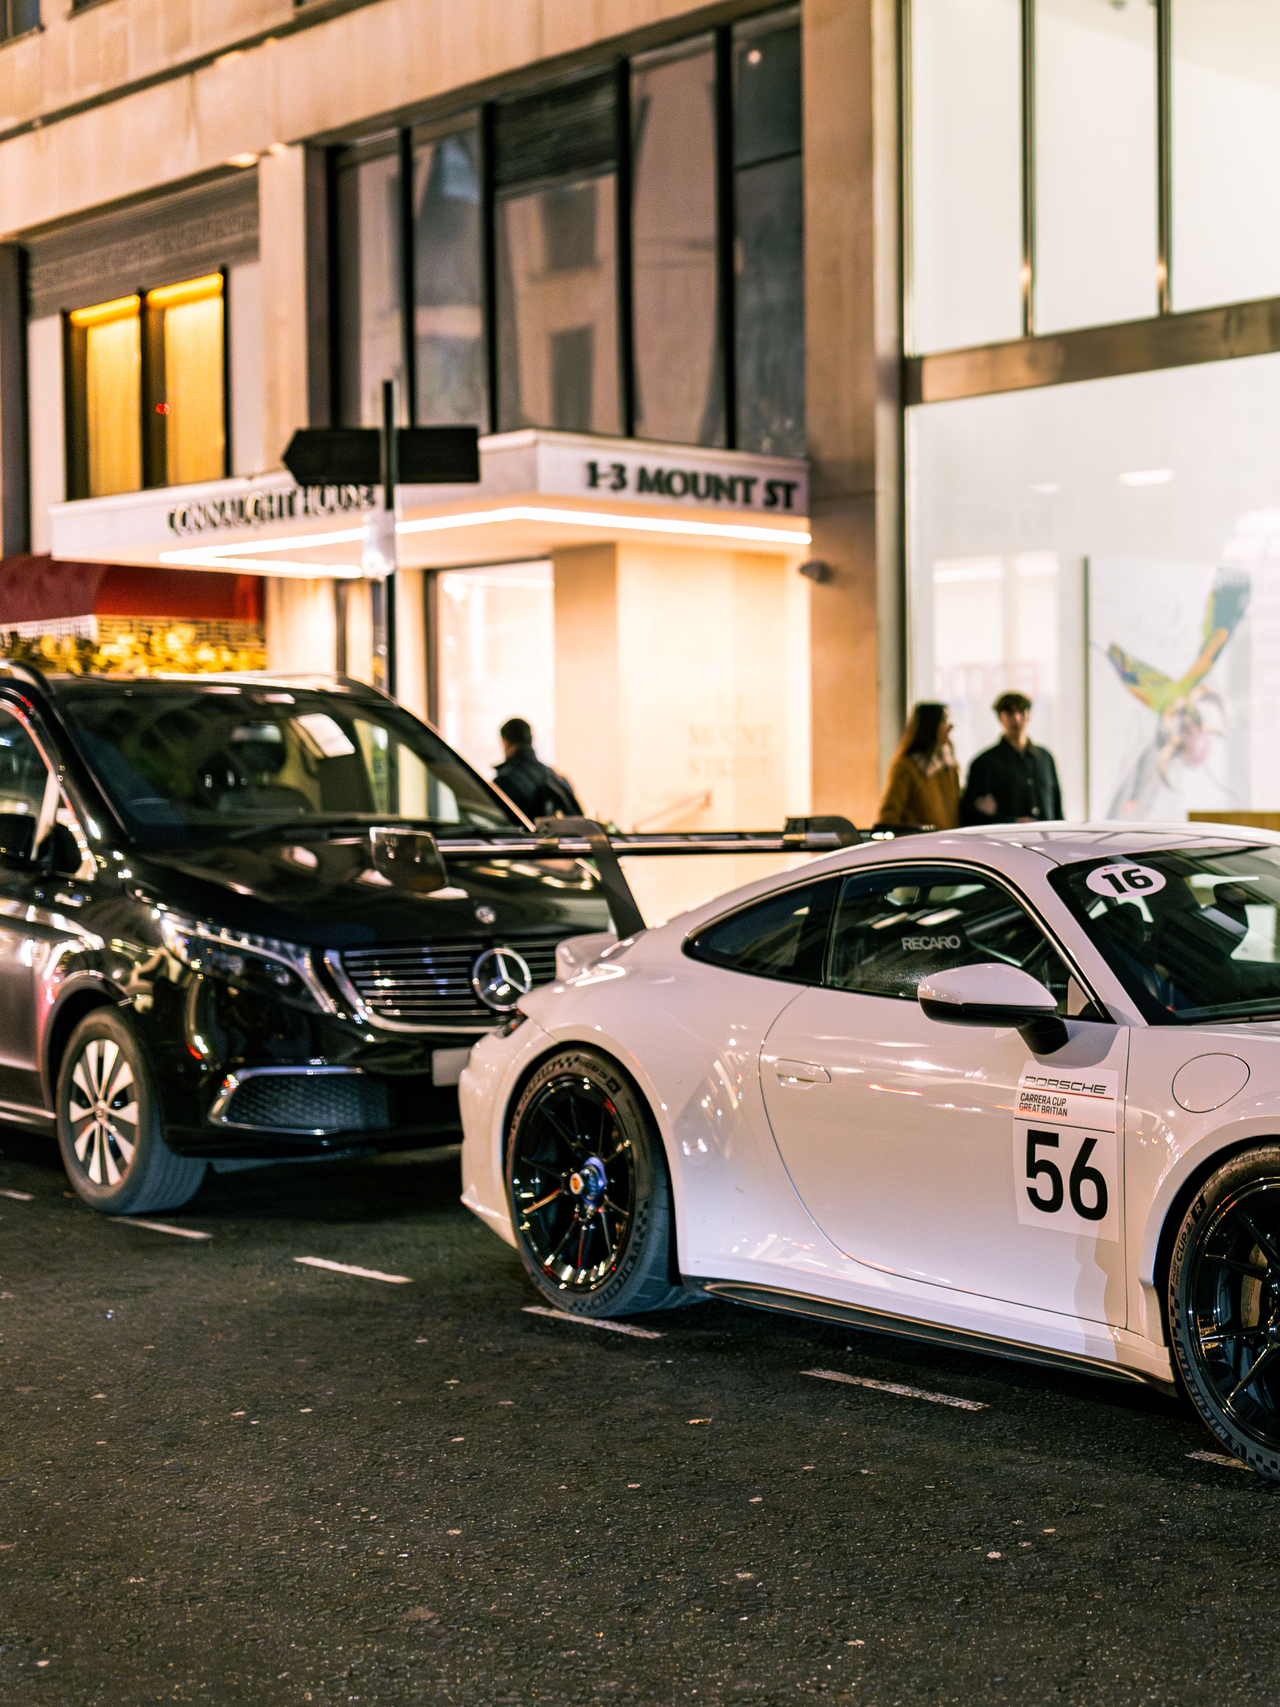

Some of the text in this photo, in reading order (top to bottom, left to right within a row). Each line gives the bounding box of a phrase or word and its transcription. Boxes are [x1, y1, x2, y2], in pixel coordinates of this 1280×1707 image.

[586, 459, 800, 510] 1-3 MOUNT ST
[1101, 868, 1154, 894] 16
[901, 935, 961, 950] RECARO
[1023, 1075, 1107, 1095] PORSCHE
[1018, 1101, 1068, 1117] GREAT BRITIAN
[1020, 1092, 1067, 1107] CARRERA CUP
[1025, 1129, 1108, 1222] 56
[1176, 1345, 1229, 1440] MICHELIN
